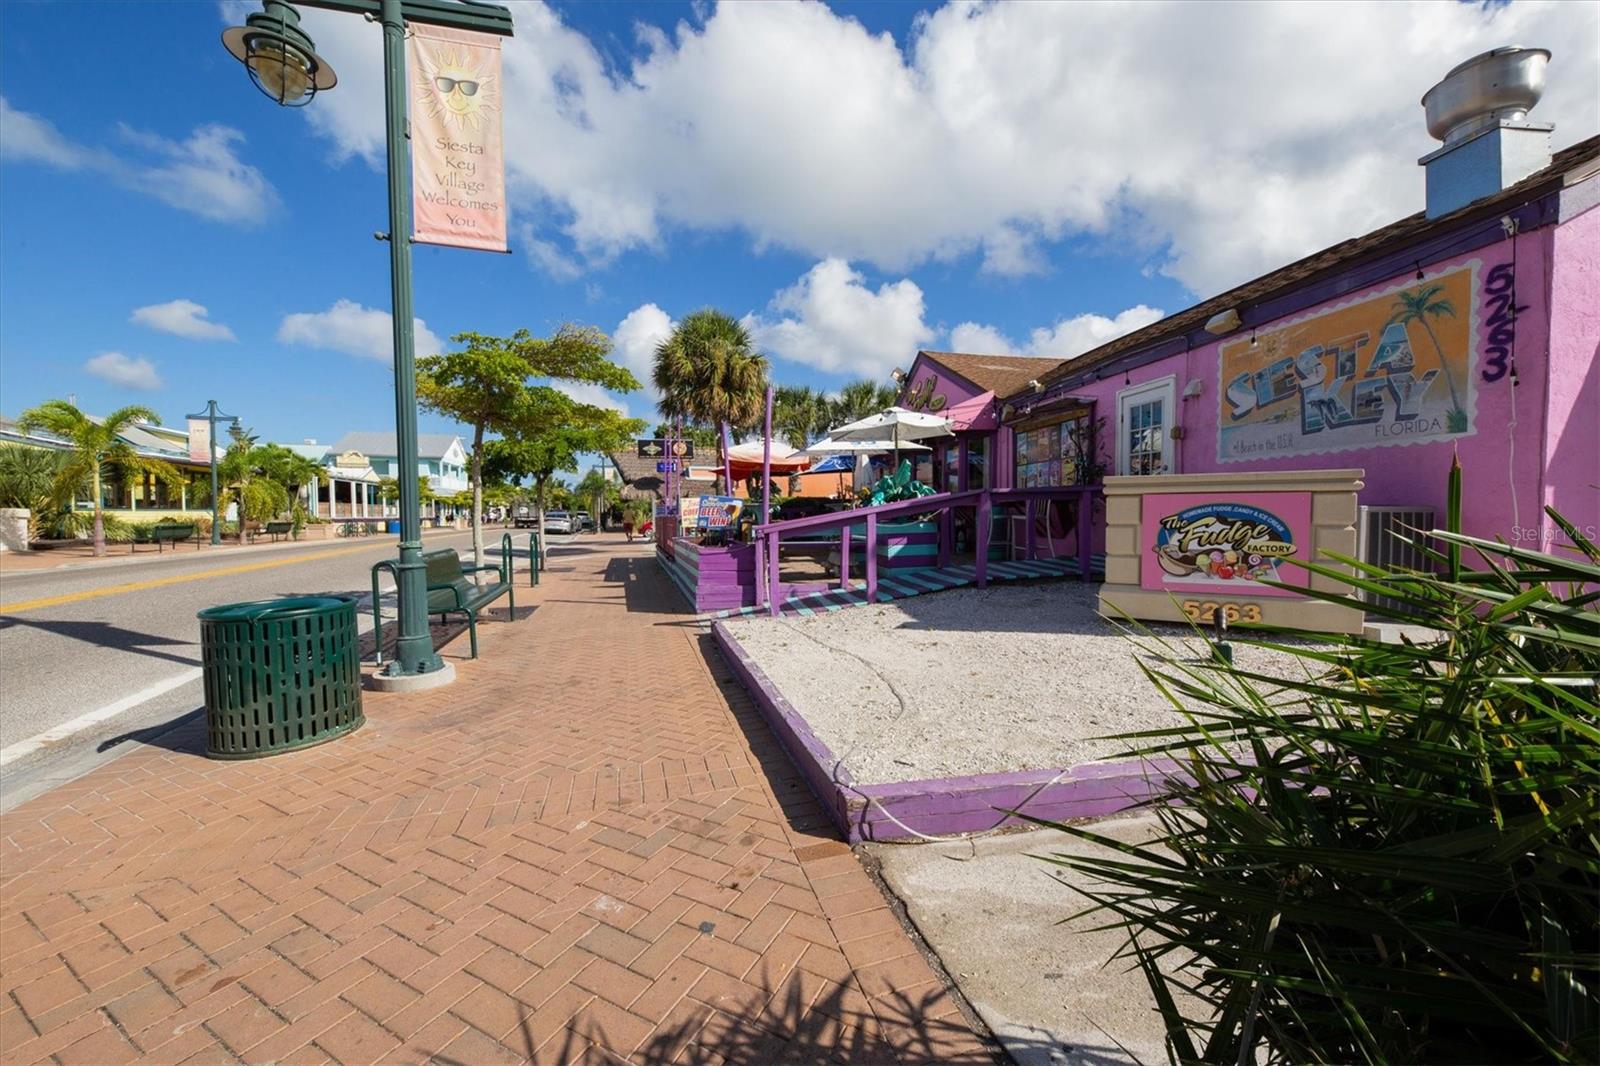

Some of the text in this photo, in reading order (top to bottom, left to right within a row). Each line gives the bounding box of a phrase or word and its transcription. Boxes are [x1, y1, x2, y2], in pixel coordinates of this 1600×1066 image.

[435, 136, 484, 155] Siesta
[445, 156, 476, 177] Key
[435, 172, 485, 196] Village
[422, 190, 498, 211] Welcomes
[446, 213, 476, 227] You
[1482, 262, 1530, 382] 5263
[1225, 322, 1415, 421] SIESTA
[1301, 368, 1440, 435] KEY
[1375, 417, 1442, 437] FLORIDA
[702, 506, 721, 517] BEER
[1213, 505, 1232, 513] FUDGE
[1161, 514, 1188, 530] The
[1179, 516, 1272, 553] Fudge
[1247, 544, 1292, 553] FACTORY
[1183, 600, 1263, 623] 5263
